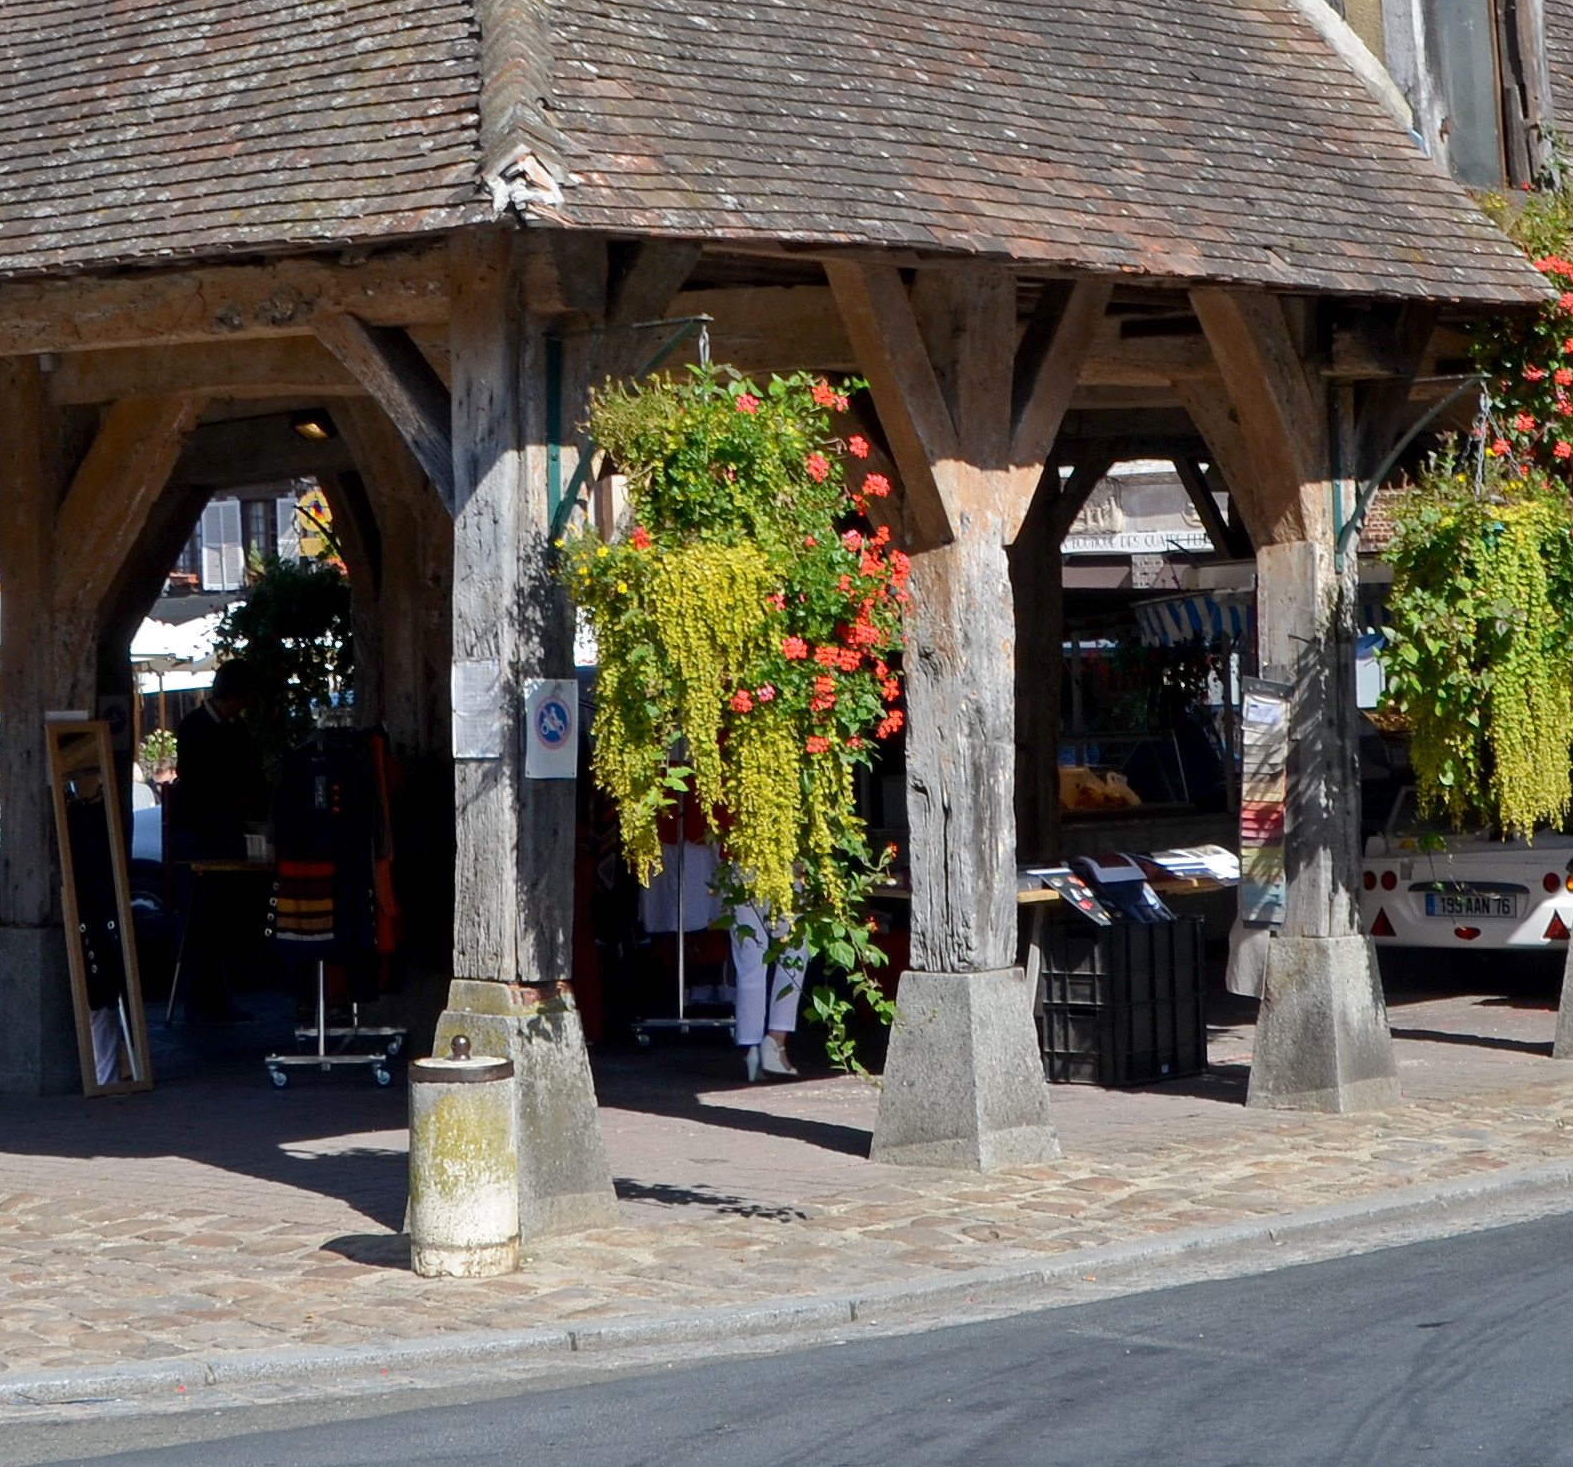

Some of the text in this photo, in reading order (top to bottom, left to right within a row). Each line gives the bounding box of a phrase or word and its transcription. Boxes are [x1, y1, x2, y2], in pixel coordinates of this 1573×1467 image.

[1121, 535, 1140, 548] DES
[1466, 897, 1490, 914] AAN
[1493, 897, 1511, 915] 76
